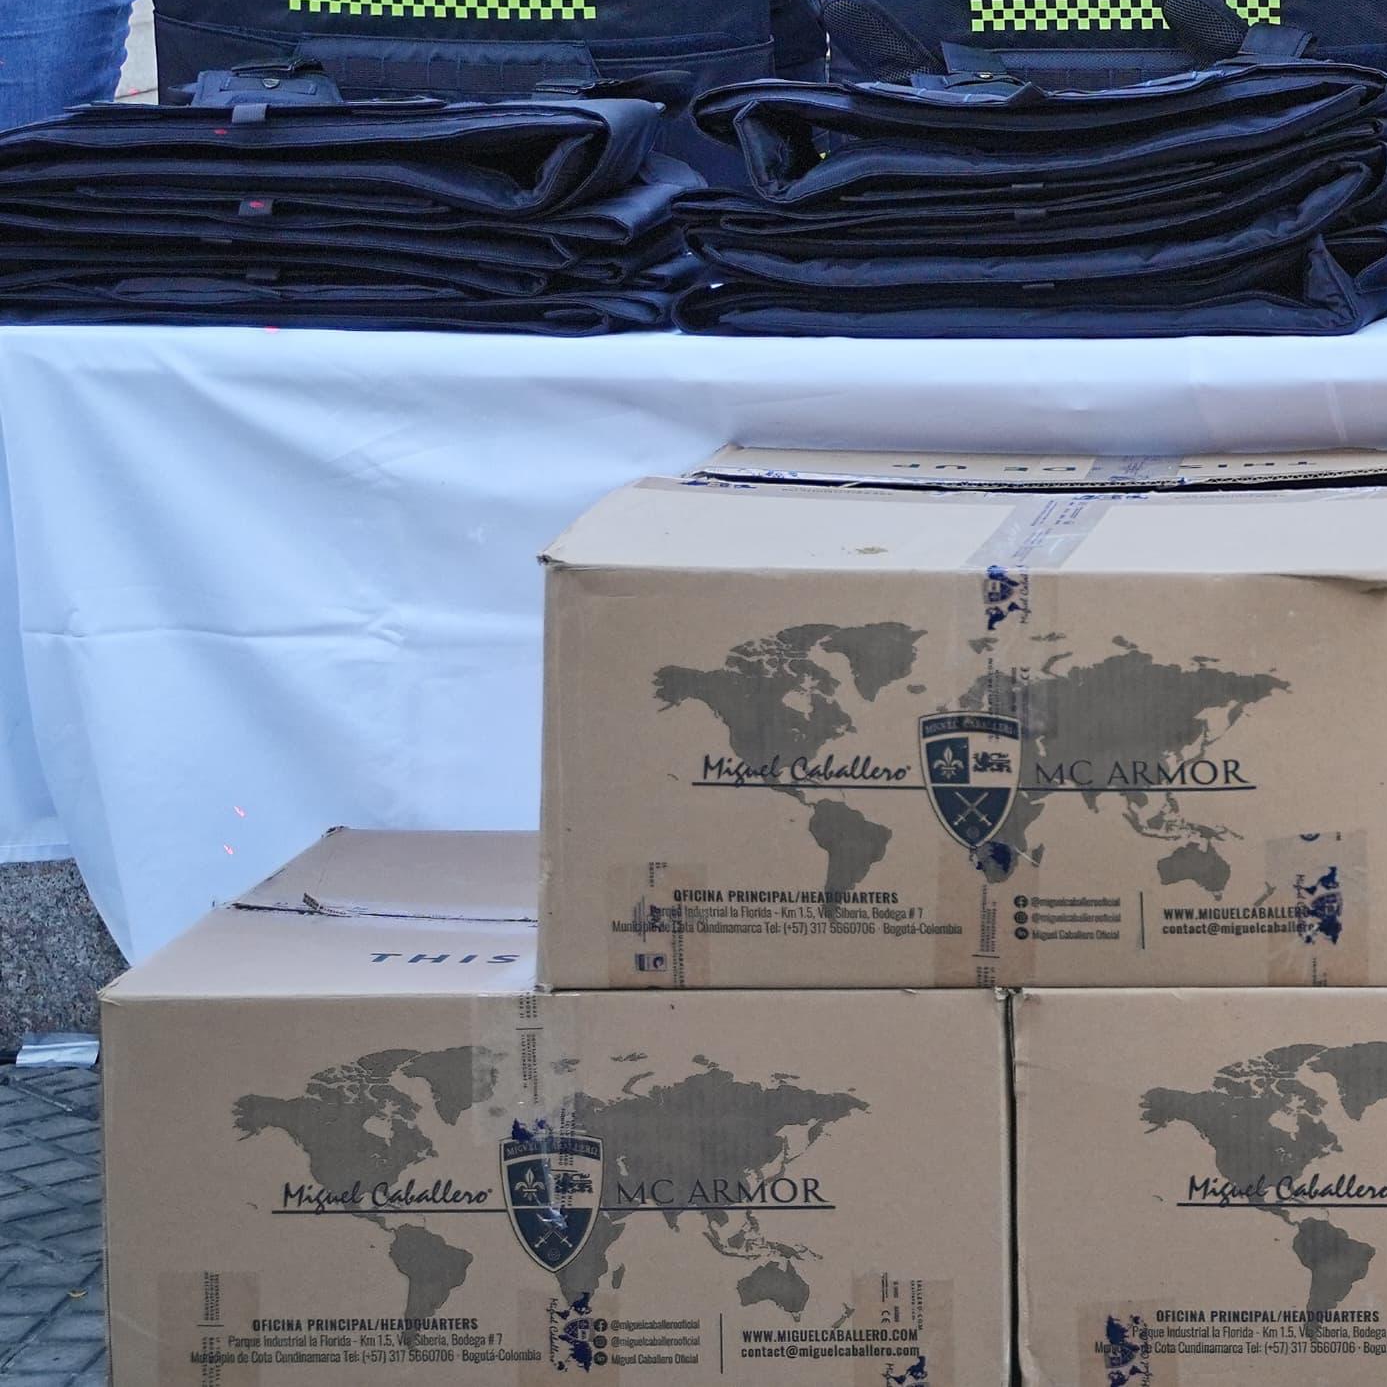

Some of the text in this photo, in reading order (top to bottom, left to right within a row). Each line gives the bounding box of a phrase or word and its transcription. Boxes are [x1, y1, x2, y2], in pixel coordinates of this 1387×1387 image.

[702, 753, 909, 788] Miguel Caballero
[1034, 759, 1249, 788] MC ARMOR
[674, 888, 898, 906] OFICINA PRINCIPAL/HEADQUARTERS
[370, 952, 521, 964] THIS
[282, 1176, 490, 1216] Miguel Caballero
[615, 1175, 829, 1207] MC ARMOR
[1187, 1173, 1267, 1209] Miguel
[252, 1314, 478, 1335] OFICINA PRINCIPAL/HEADQUARTERS
[1155, 1307, 1380, 1326] OFICINA PRINCIPAL/HEADQUARTERS
[741, 1325, 919, 1345] WWW.MIGUELCABALLERO.COM
